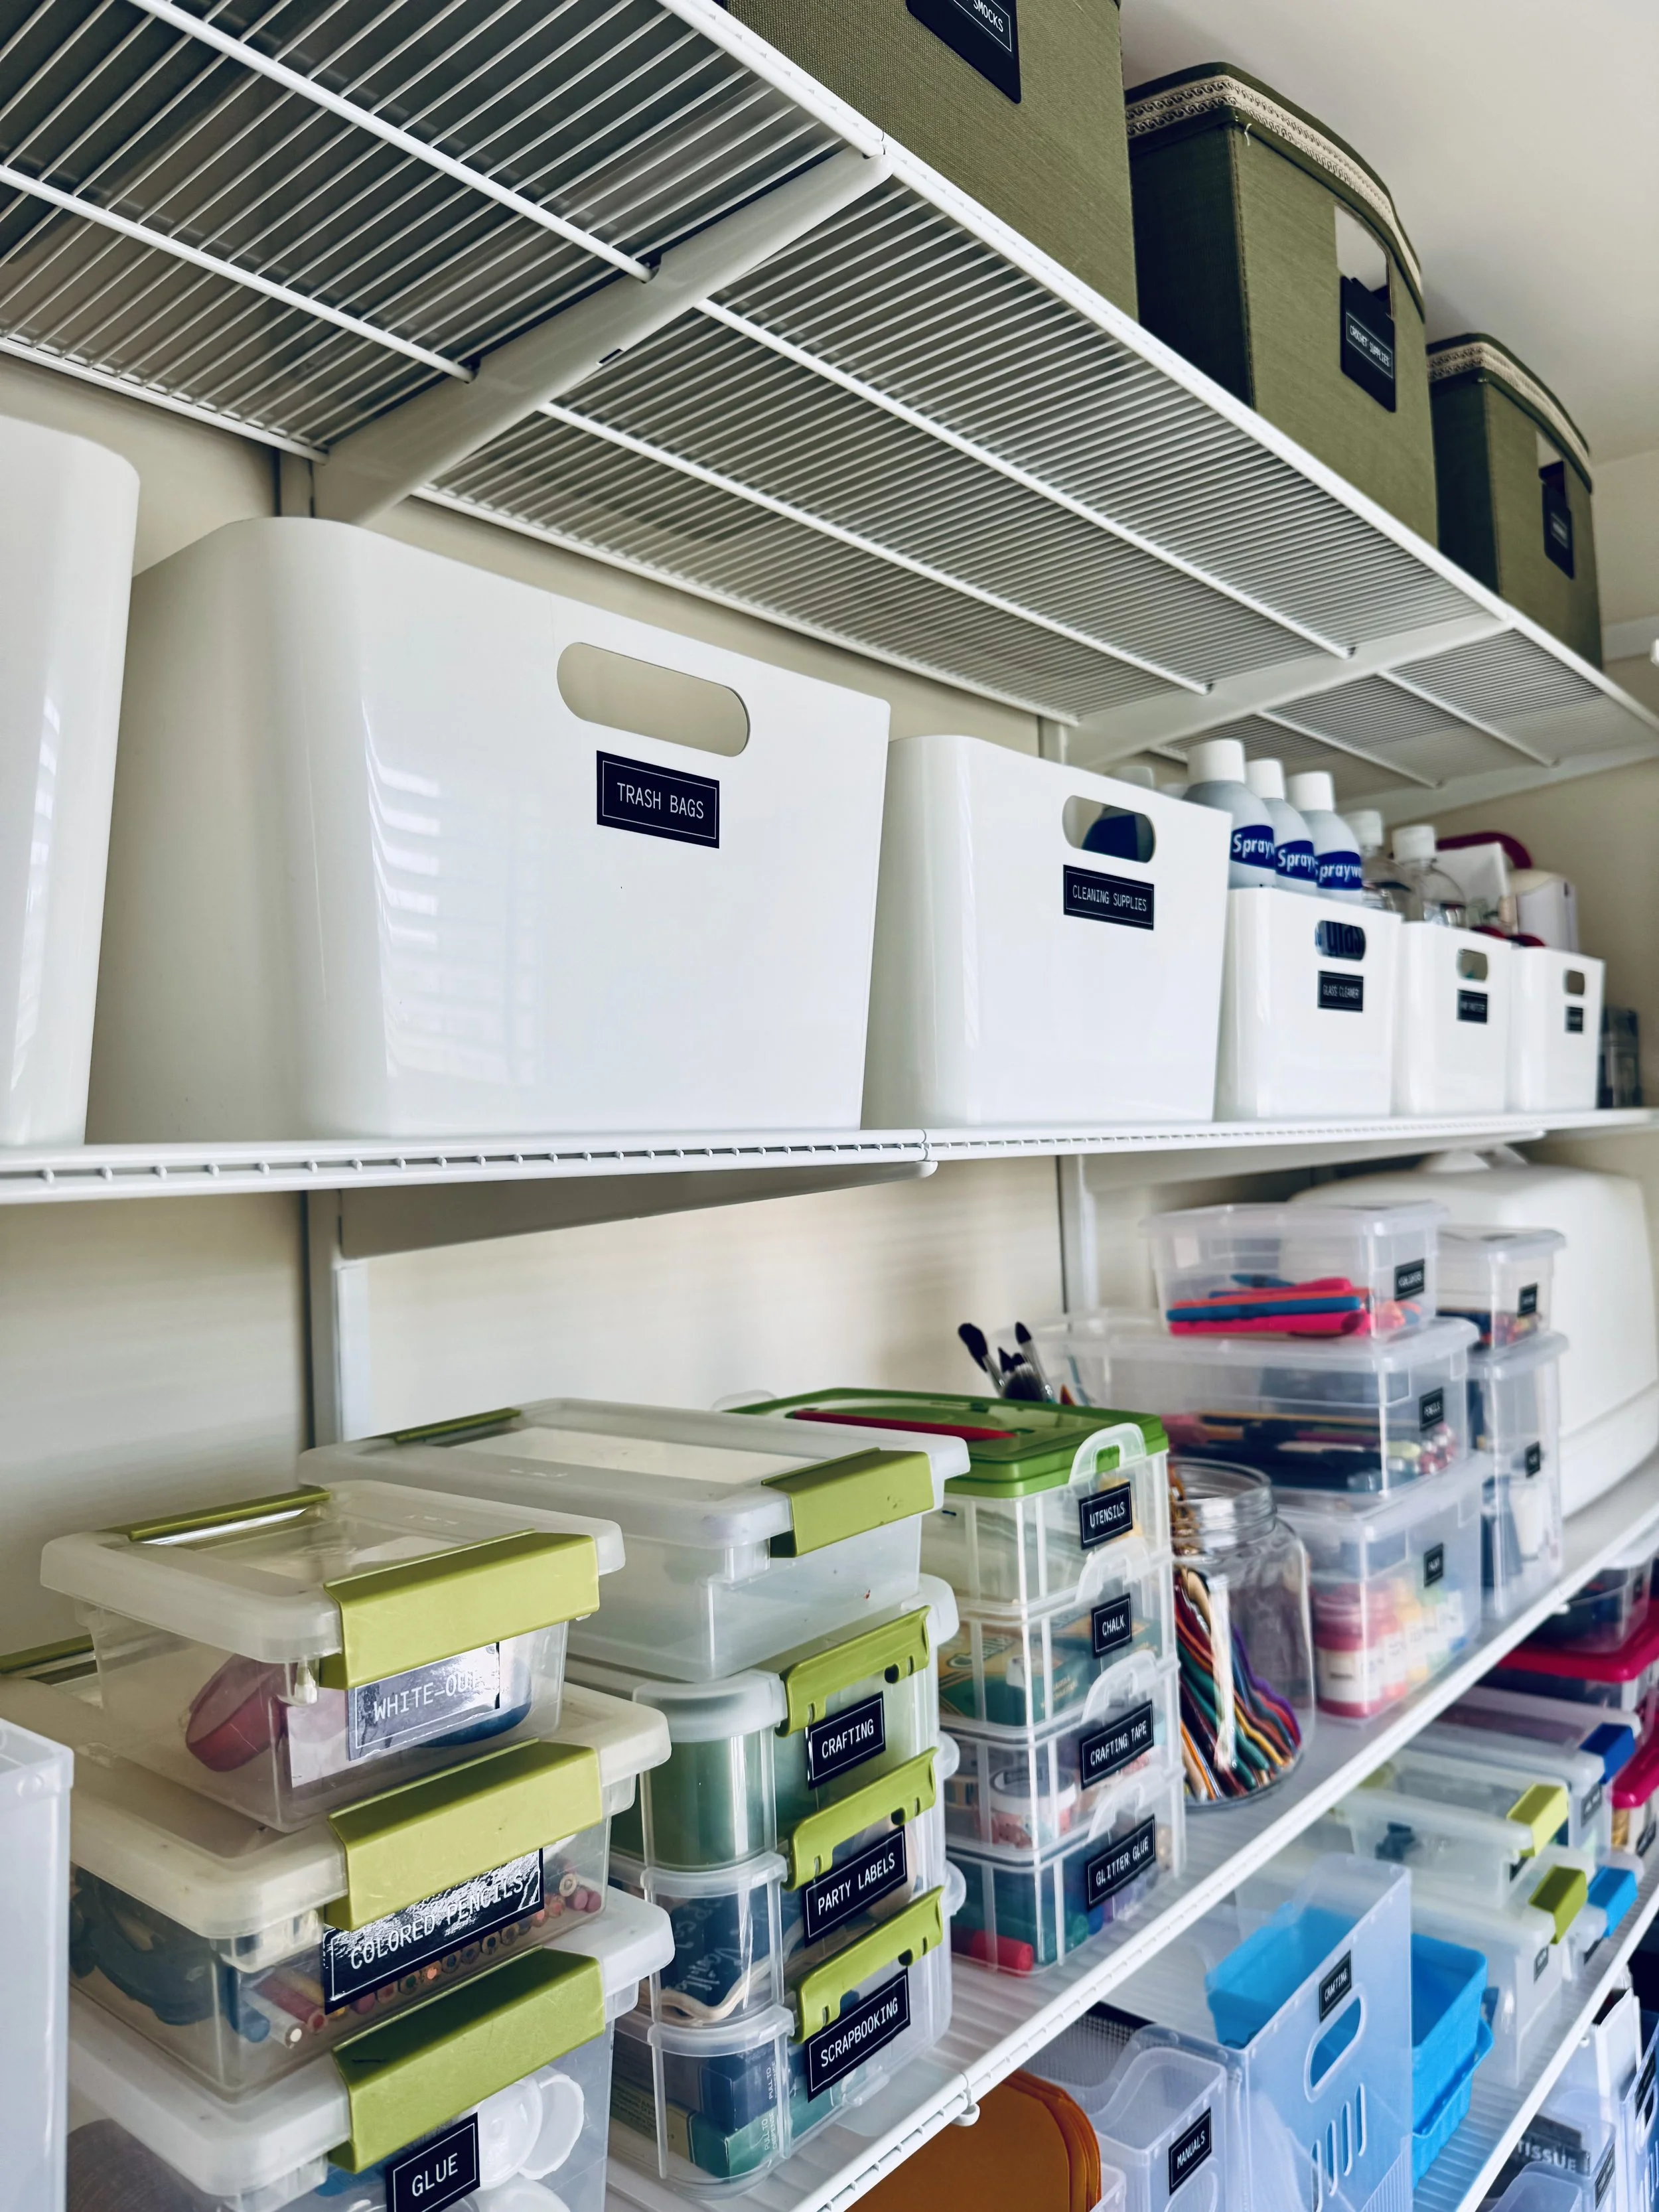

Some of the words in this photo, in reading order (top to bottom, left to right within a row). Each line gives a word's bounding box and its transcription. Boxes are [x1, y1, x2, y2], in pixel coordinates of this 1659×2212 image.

[973, 0, 1003, 33] SMOCKS
[617, 782, 661, 810] TRASH
[670, 794, 704, 819] BAGS
[1072, 885, 1110, 905] CLEANING
[1113, 893, 1147, 912] SUPPLIES
[1090, 1501, 1125, 1528] UTENSILS
[1102, 1614, 1125, 1636] CHALK
[822, 1718, 874, 1759] CRAFTING
[1090, 1733, 1128, 1766] CRAFTING
[1131, 1720, 1147, 1742] TAPE
[1096, 1852, 1130, 1887] GLITTER
[1132, 1836, 1149, 1861] GLUE
[818, 1880, 851, 1915] PARTY
[858, 1852, 895, 1890] LABELS
[350, 1915, 435, 1970] COLORED
[447, 1874, 524, 1925] PENCILS
[1324, 1968, 1347, 2002] CRAFTING
[821, 1997, 898, 2067] SCRAPBOOKING
[1177, 2130, 1206, 2170] MANUALS
[1517, 2140, 1576, 2174] TISSUE
[411, 2152, 459, 2197] GLUE
